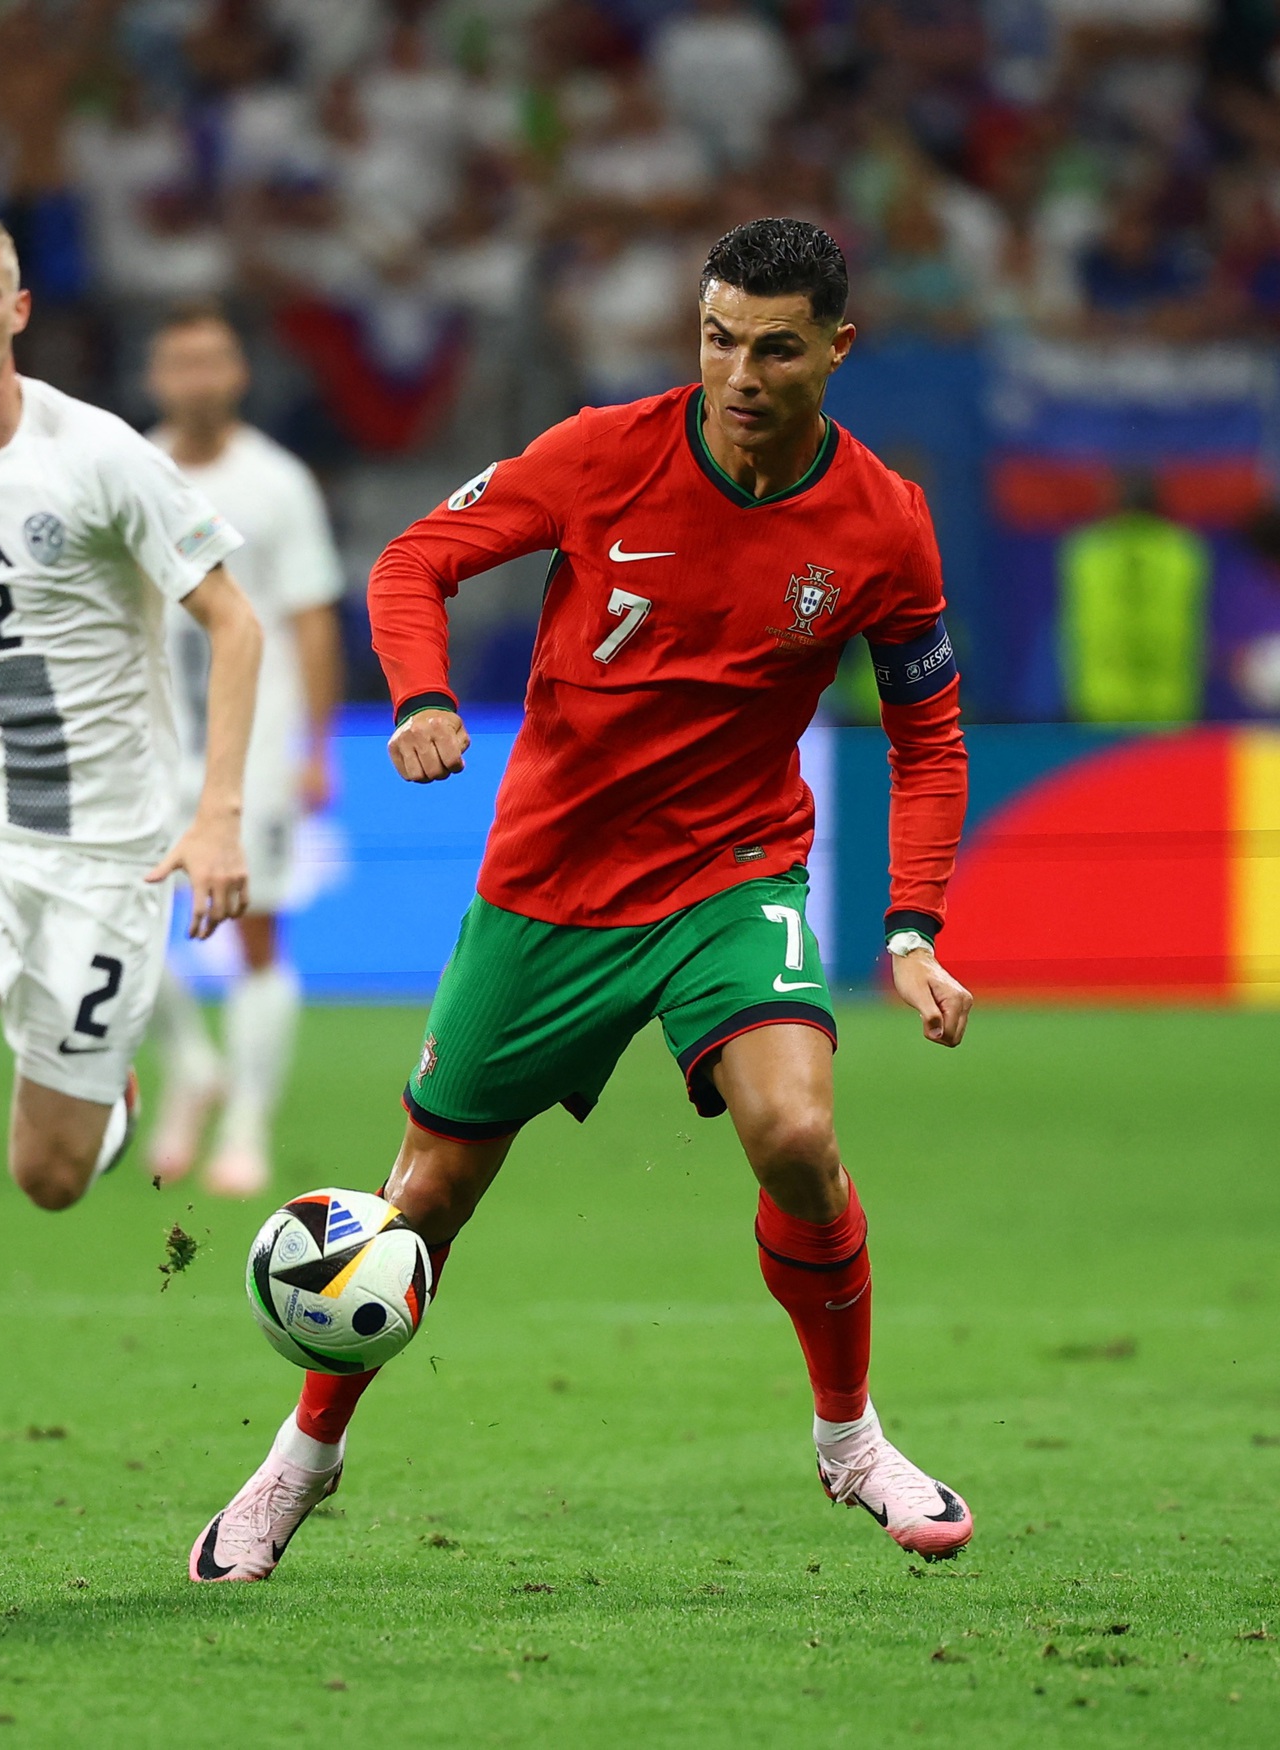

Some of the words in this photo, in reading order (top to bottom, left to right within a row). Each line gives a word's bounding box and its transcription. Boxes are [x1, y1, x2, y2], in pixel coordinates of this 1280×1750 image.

[592, 587, 652, 664] 7
[923, 635, 952, 671] RESPEC
[760, 904, 804, 971] 7
[74, 953, 123, 1039] 2
